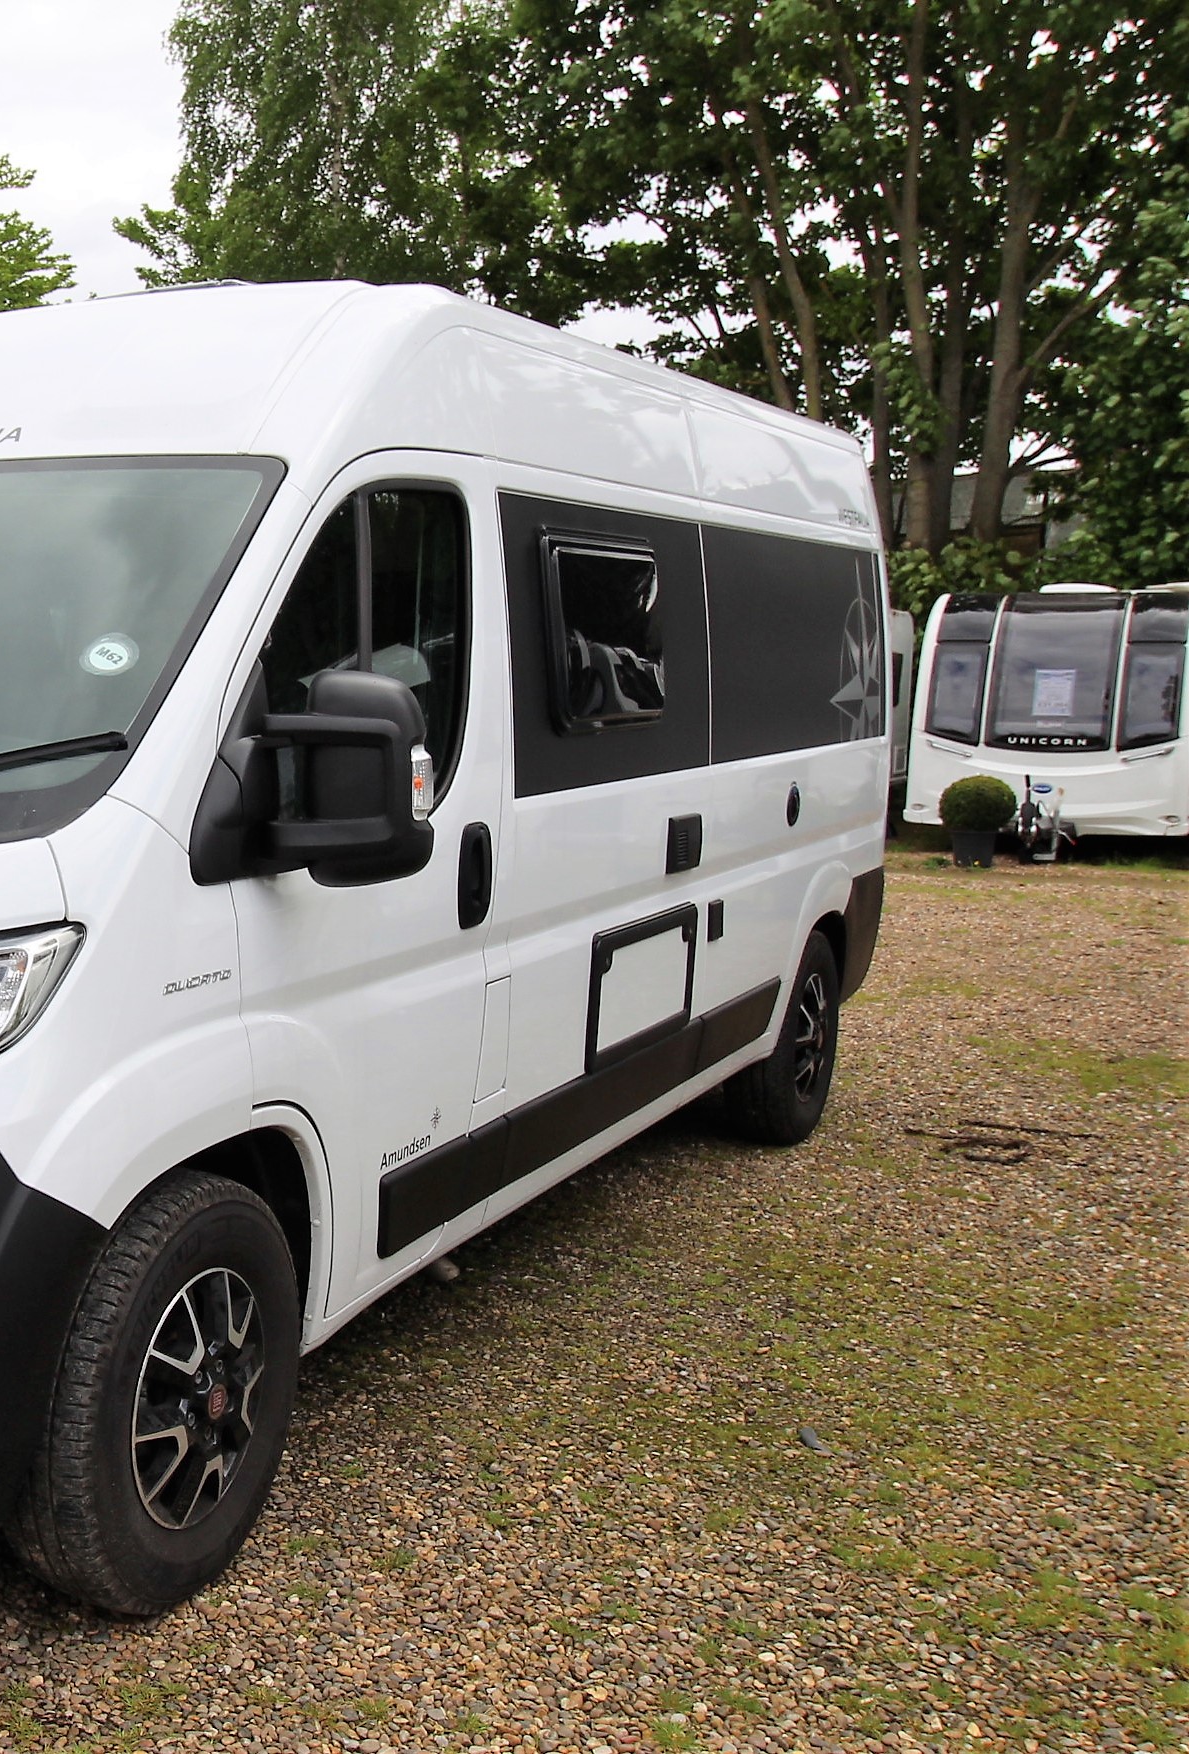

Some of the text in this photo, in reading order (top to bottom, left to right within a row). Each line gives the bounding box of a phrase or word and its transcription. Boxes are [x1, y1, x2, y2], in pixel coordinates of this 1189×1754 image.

[96, 646, 123, 664] M62
[1007, 736, 1088, 746] UNICORN
[162, 969, 232, 996] DUCATO
[380, 1134, 431, 1170] Amundsen
